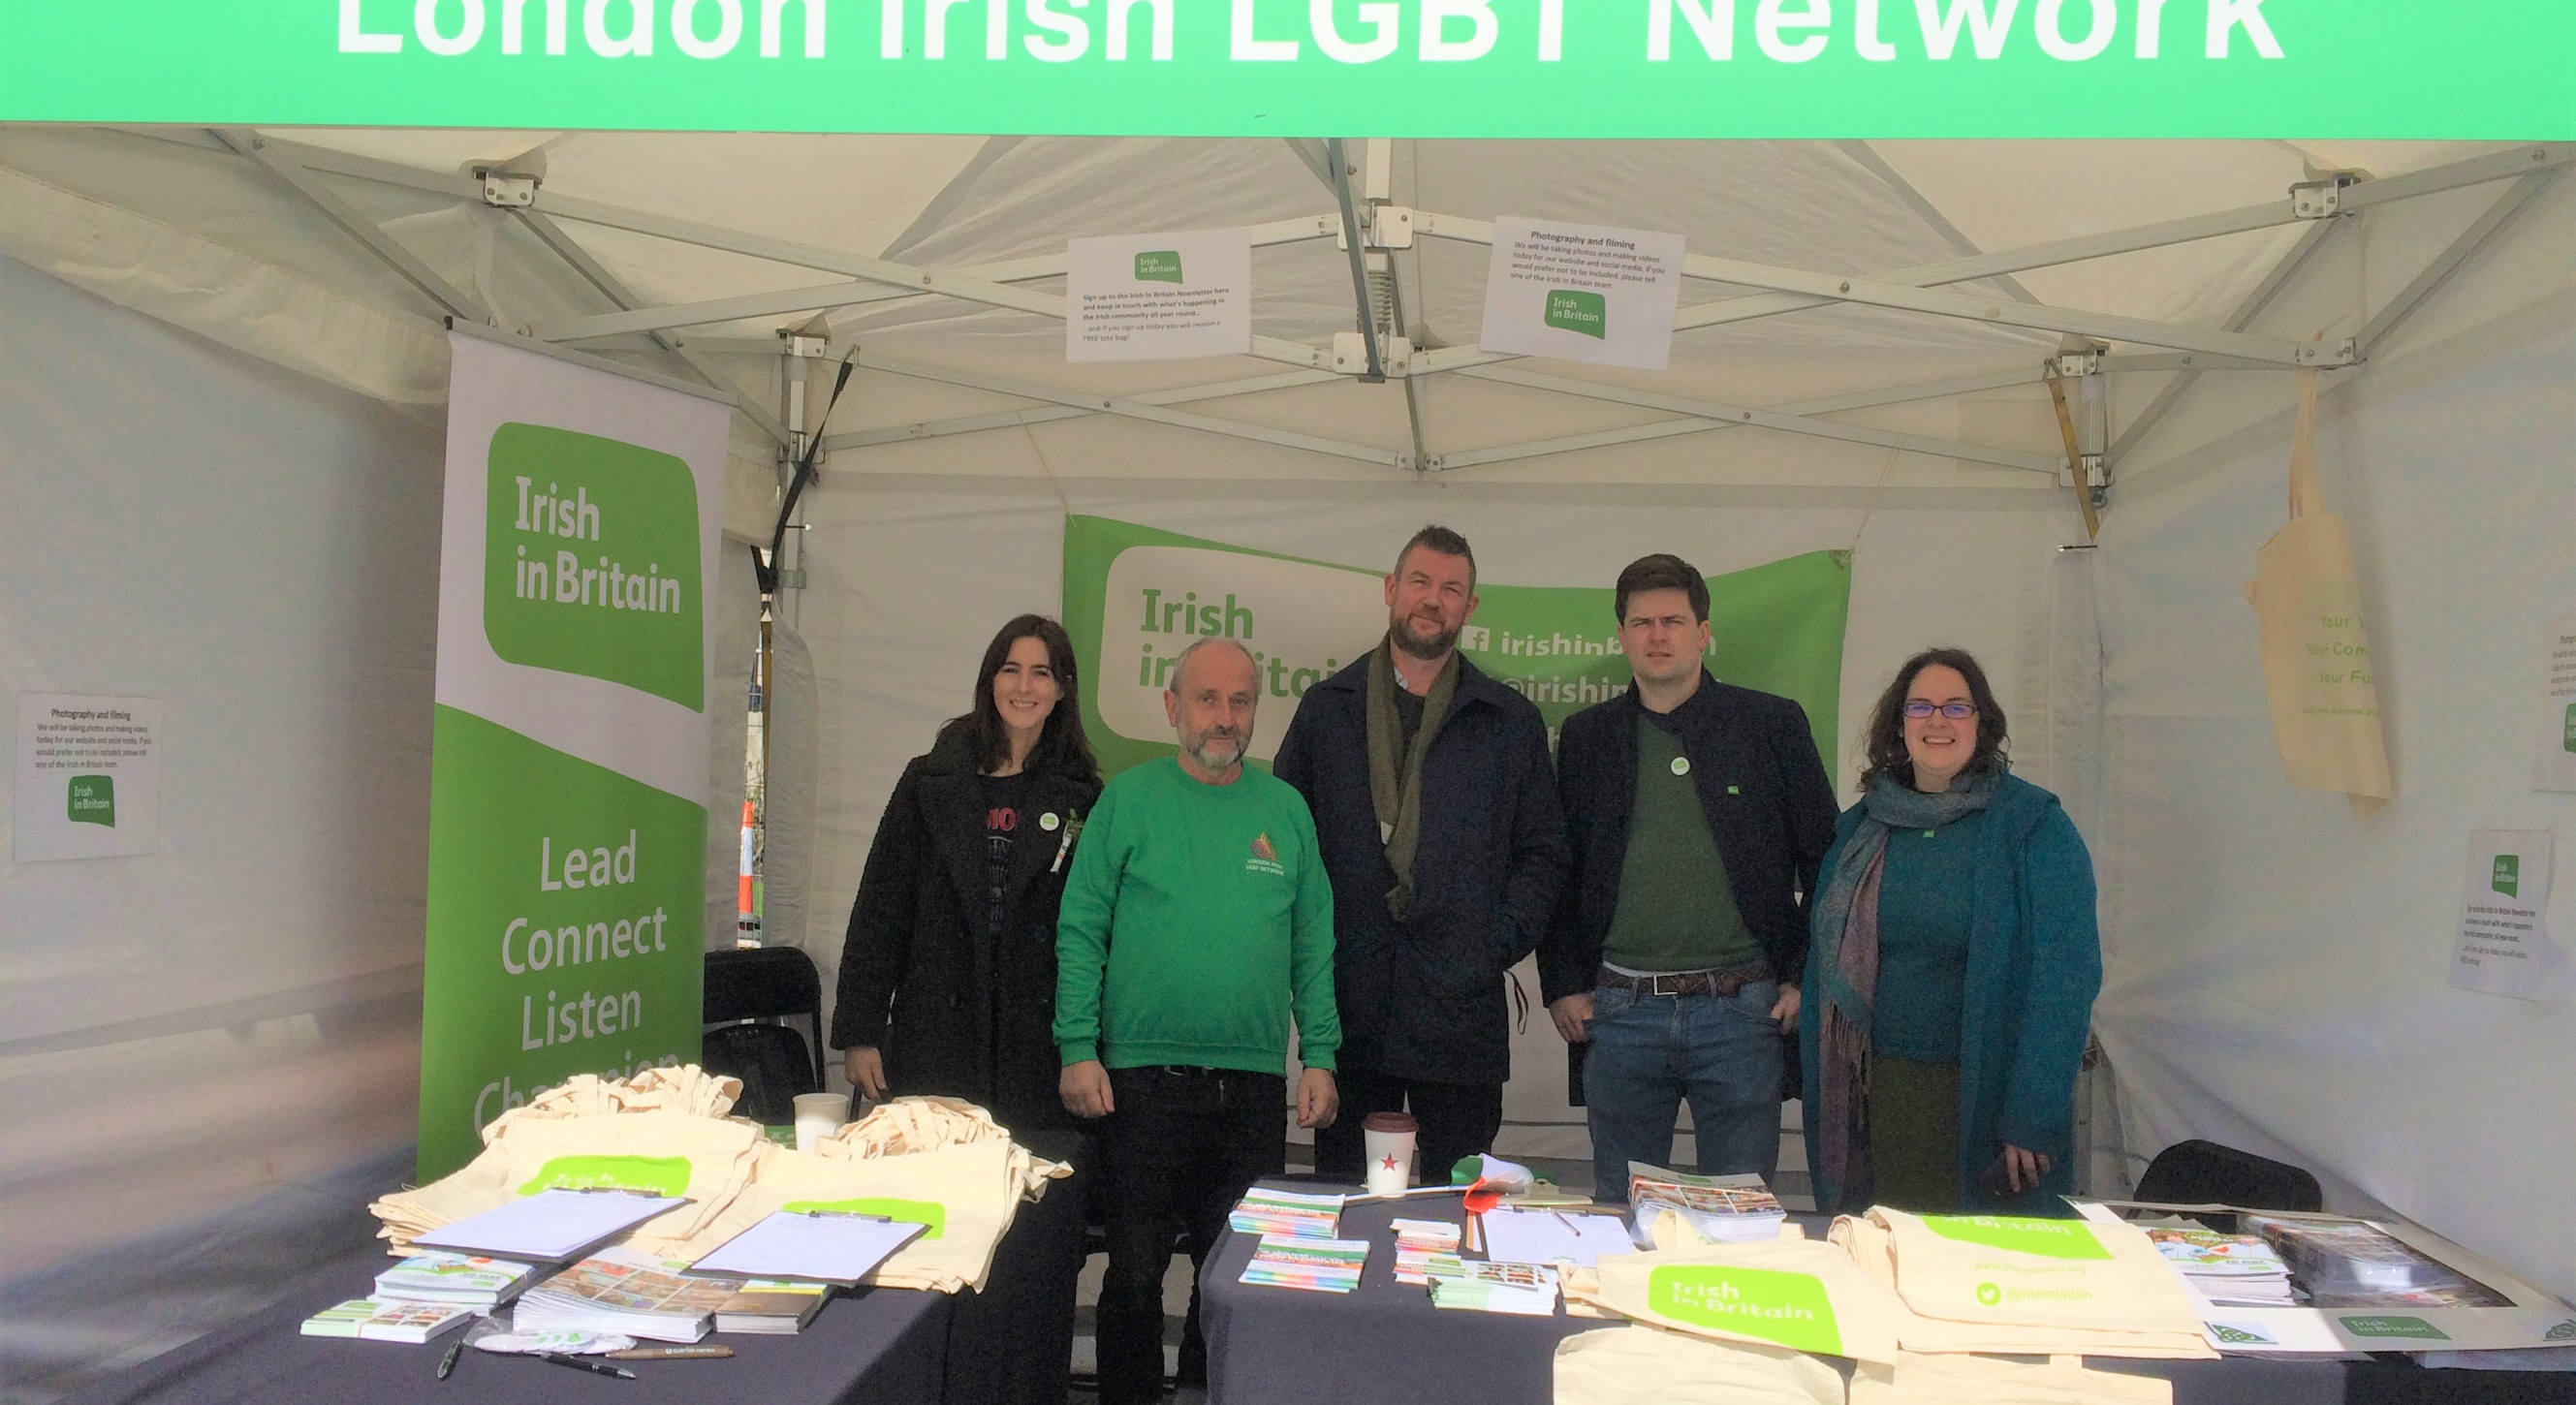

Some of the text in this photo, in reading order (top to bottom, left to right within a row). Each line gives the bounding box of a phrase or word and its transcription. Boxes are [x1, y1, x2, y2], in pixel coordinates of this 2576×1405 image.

[337, 0, 826, 59] London
[880, 0, 1175, 63] Irish
[1647, 0, 2286, 63] Network
[1531, 231, 1586, 245] Photography
[1606, 238, 1635, 250] filming
[1140, 257, 1159, 265] Irish
[1513, 252, 1532, 261] today
[1558, 257, 1585, 265] website
[1551, 246, 1571, 255] taking
[1572, 248, 1596, 257] photos
[1613, 252, 1637, 262] making
[1149, 265, 1177, 273] Britain
[1533, 273, 1545, 282] the
[1570, 277, 1592, 286] Britain
[1621, 273, 1643, 282] please
[1182, 298, 1216, 307] happening
[1553, 297, 1577, 309] Irish
[1553, 308, 1598, 322] in Britain
[516, 475, 600, 541] Irish
[516, 545, 680, 613] in Britain
[1141, 588, 1253, 640] Irish
[2333, 641, 2368, 656] Com
[2350, 670, 2372, 684] Fu
[51, 708, 130, 721] Photography and filming
[74, 786, 93, 797] Irish
[74, 799, 110, 810] in Britain
[541, 828, 637, 891] Lead
[502, 906, 667, 975] Connect
[521, 989, 642, 1051] Listen
[1672, 1281, 1740, 1299] Irish
[2006, 1288, 2093, 1302] @irishinbritain
[1673, 1294, 1813, 1321] in Britain
